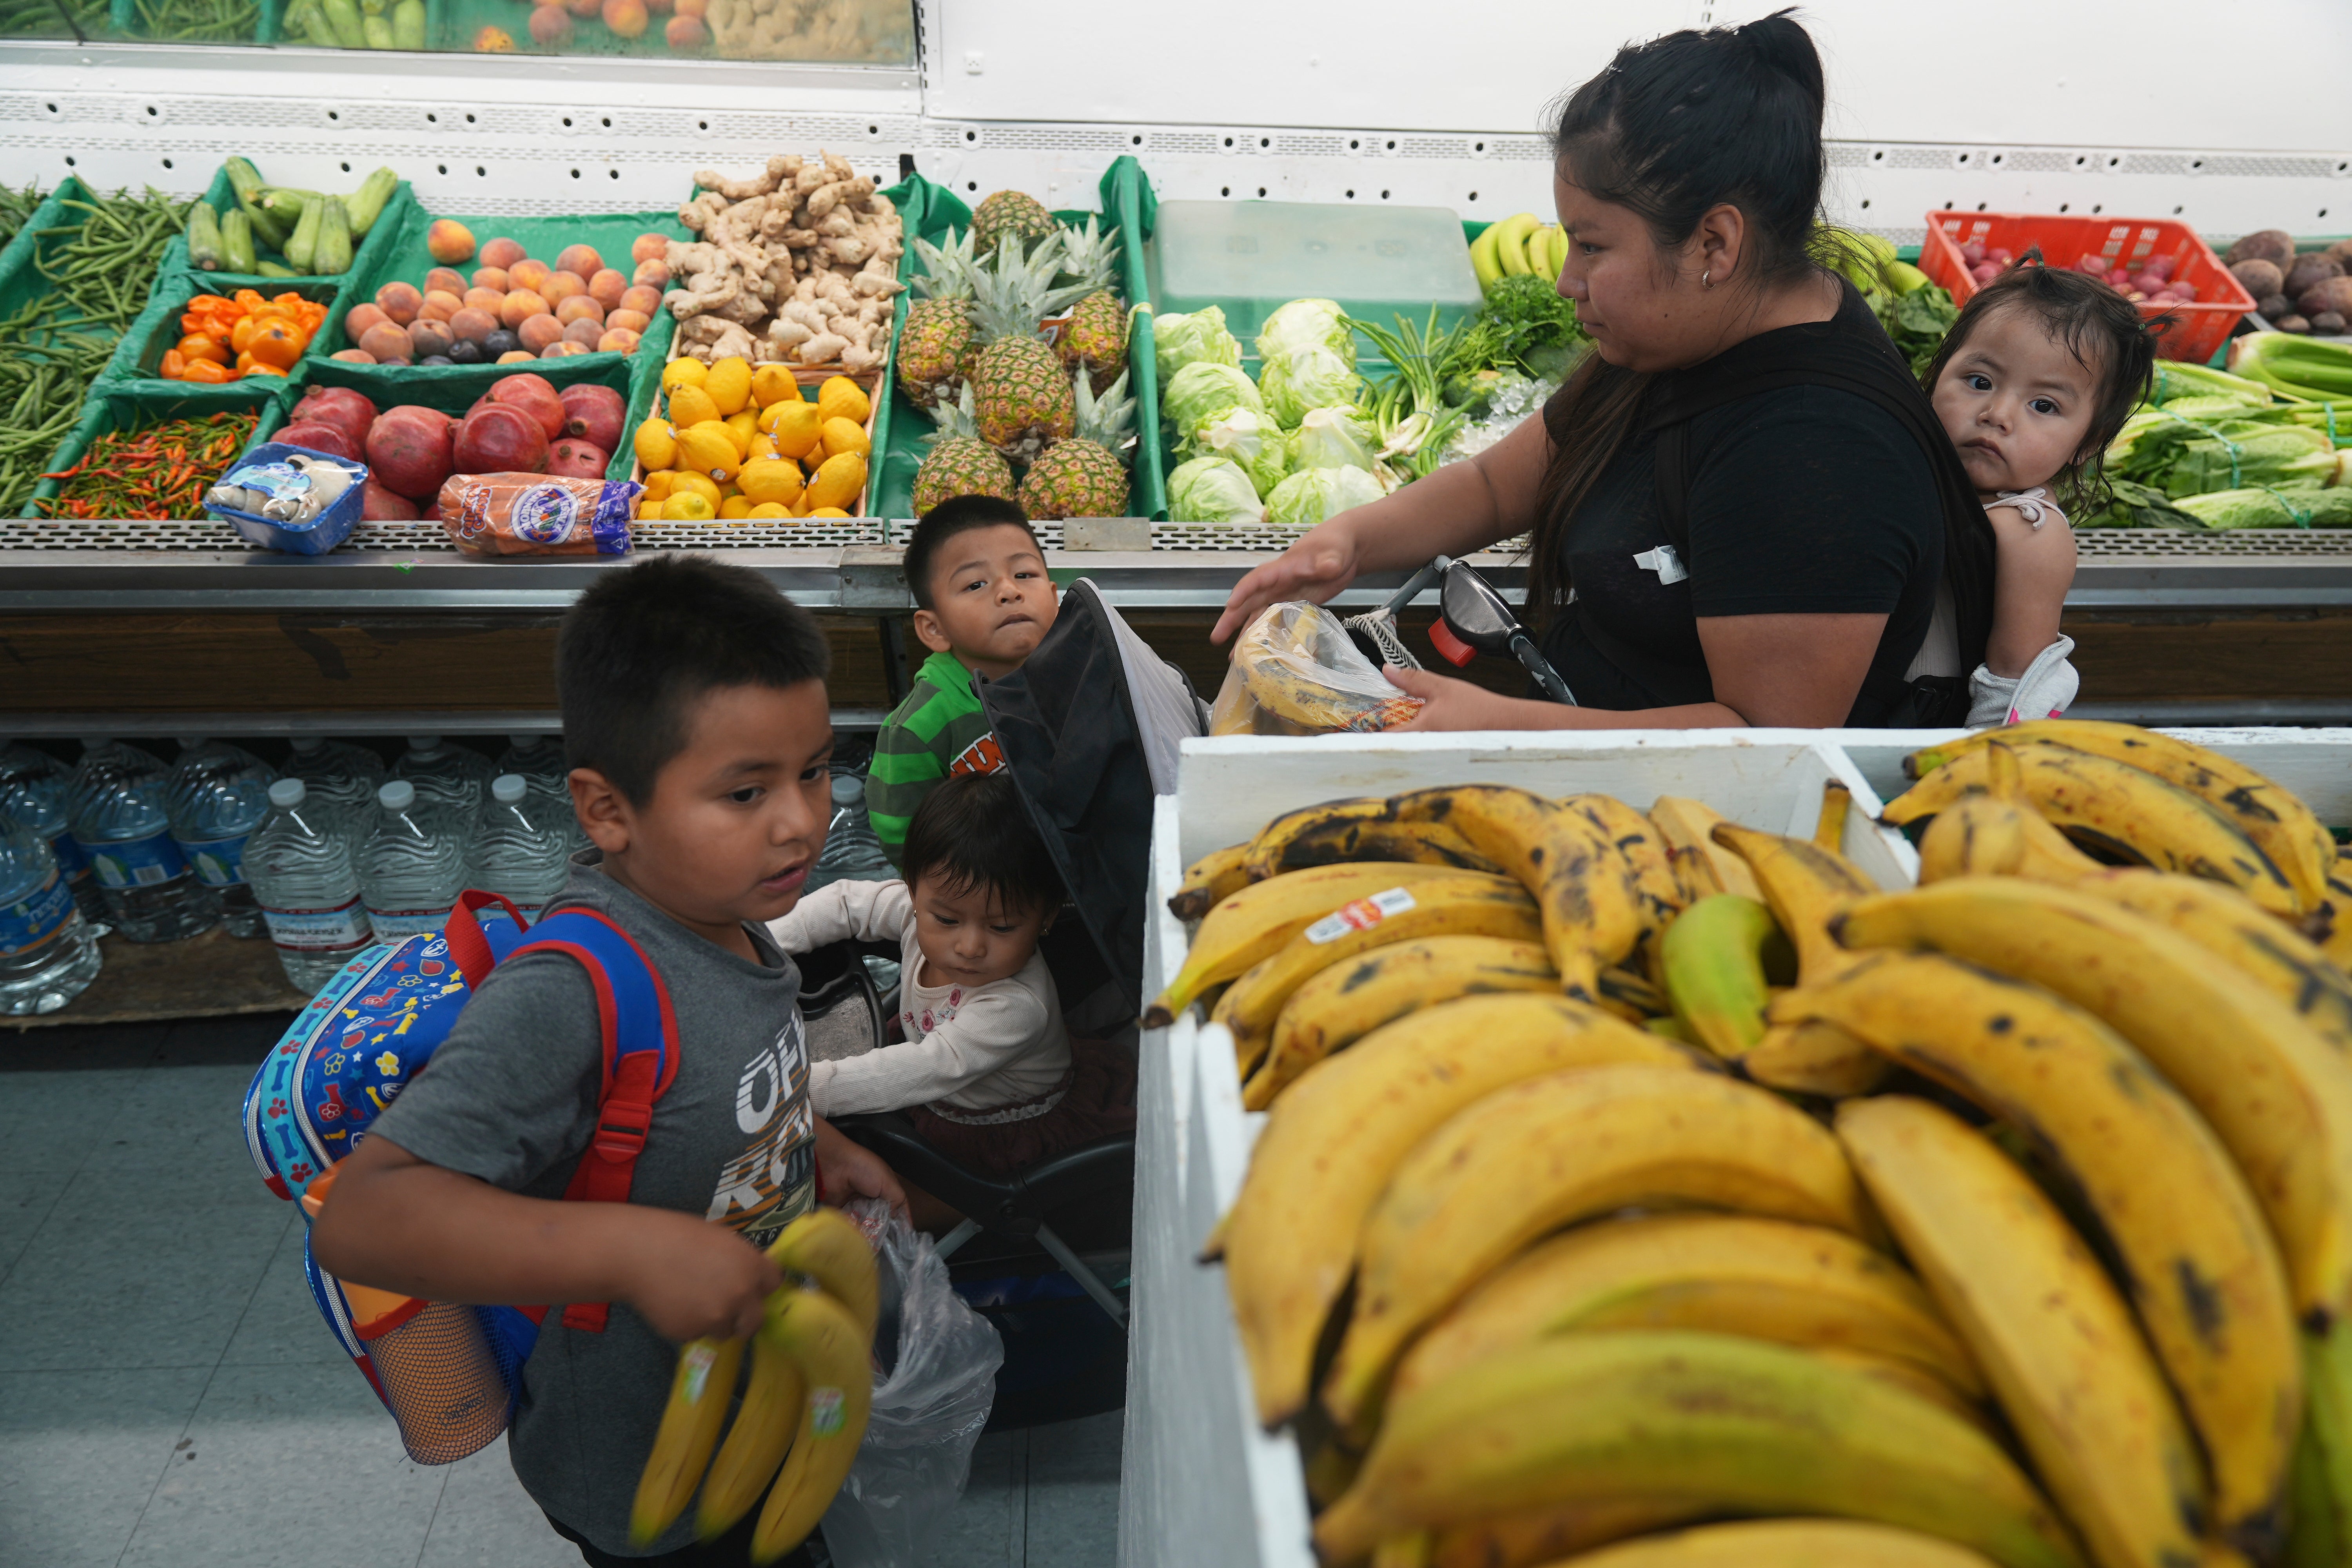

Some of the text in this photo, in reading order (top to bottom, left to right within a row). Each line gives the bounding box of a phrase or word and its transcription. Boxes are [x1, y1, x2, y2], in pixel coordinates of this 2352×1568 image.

[1347, 702, 1382, 724] PARTICIPATING
[1374, 701, 1403, 717] BREATHING.
[1396, 715, 1408, 725] AWAY
